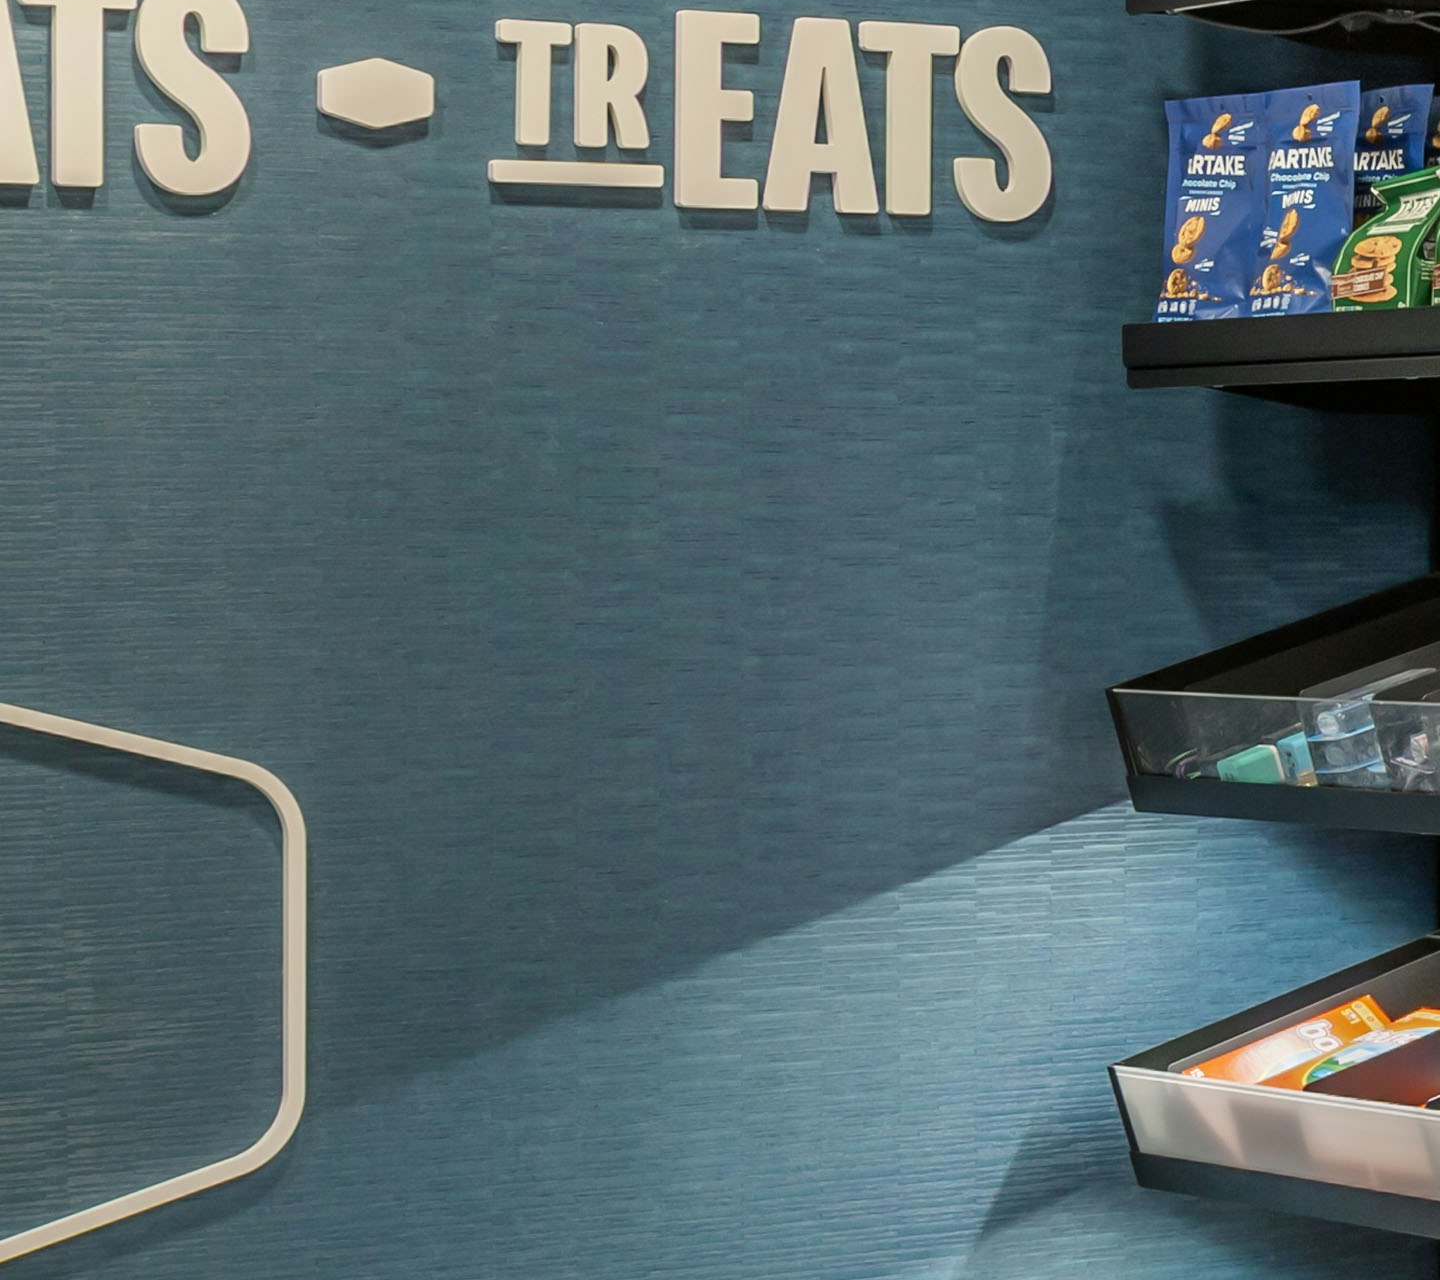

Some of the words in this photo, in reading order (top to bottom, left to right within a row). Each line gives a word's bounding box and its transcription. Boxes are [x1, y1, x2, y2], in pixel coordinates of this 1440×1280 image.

[489, 8, 1053, 223] TREATS
[1313, 172, 1330, 182] Chip
[1185, 196, 1221, 213] MINIS
